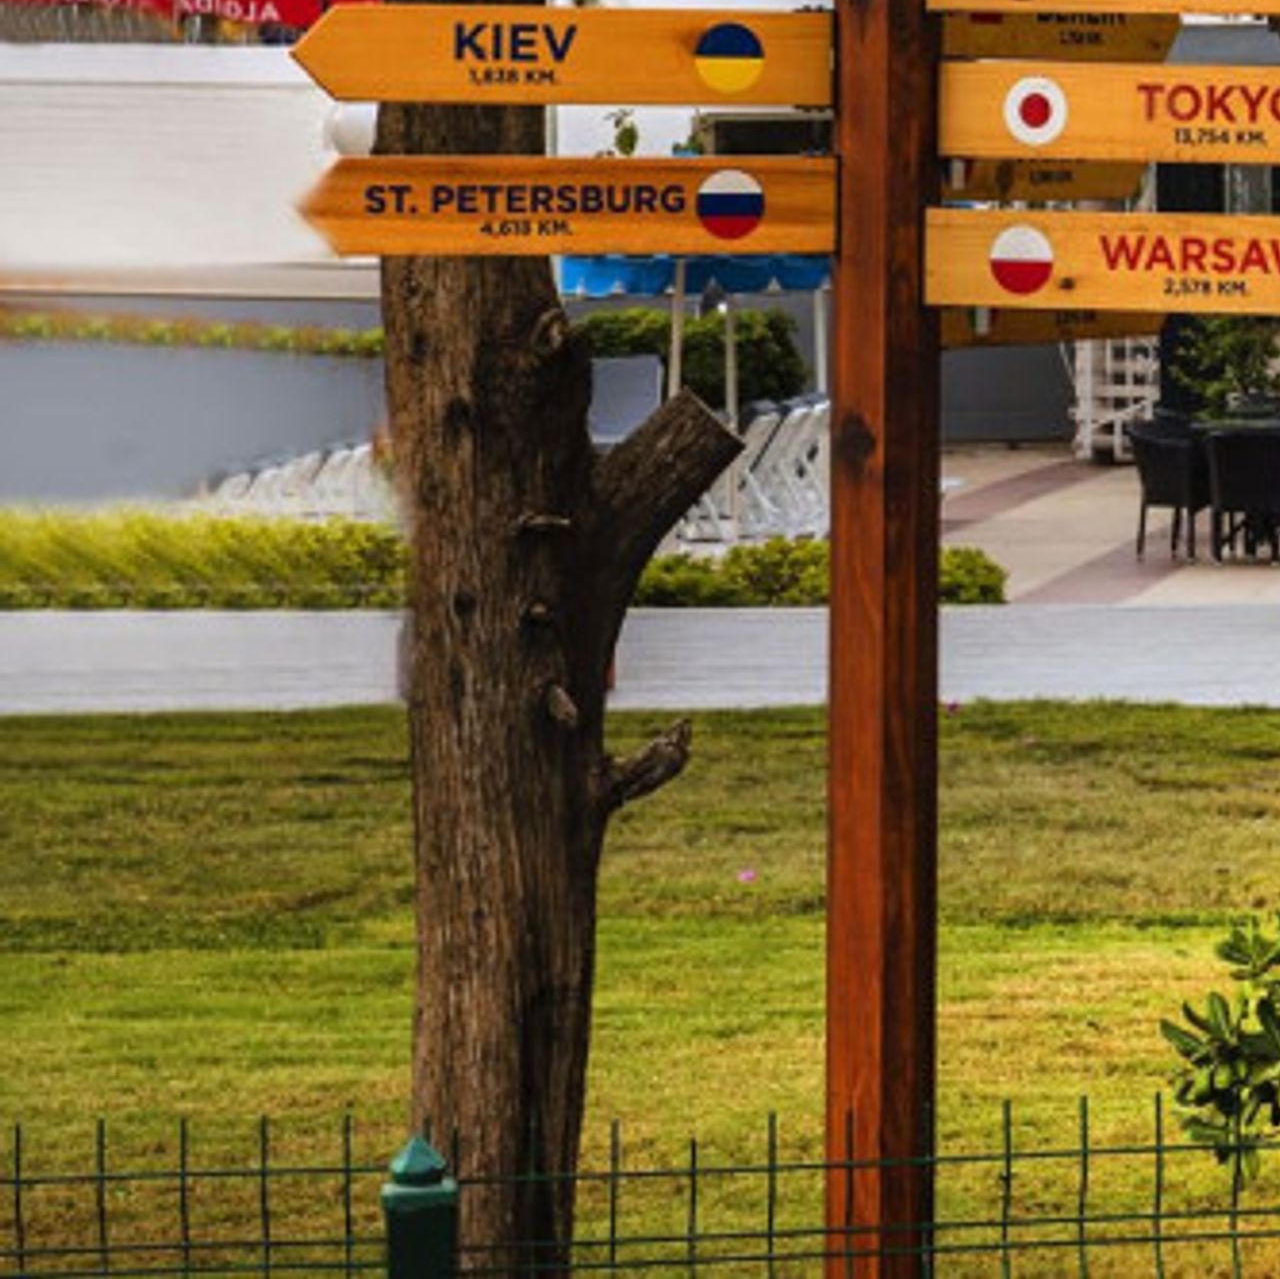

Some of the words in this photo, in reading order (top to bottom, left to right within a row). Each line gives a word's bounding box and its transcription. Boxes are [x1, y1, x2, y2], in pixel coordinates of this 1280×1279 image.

[453, 22, 577, 63] KIEV
[364, 185, 418, 214] ST.
[430, 185, 687, 215] PETERSBURG
